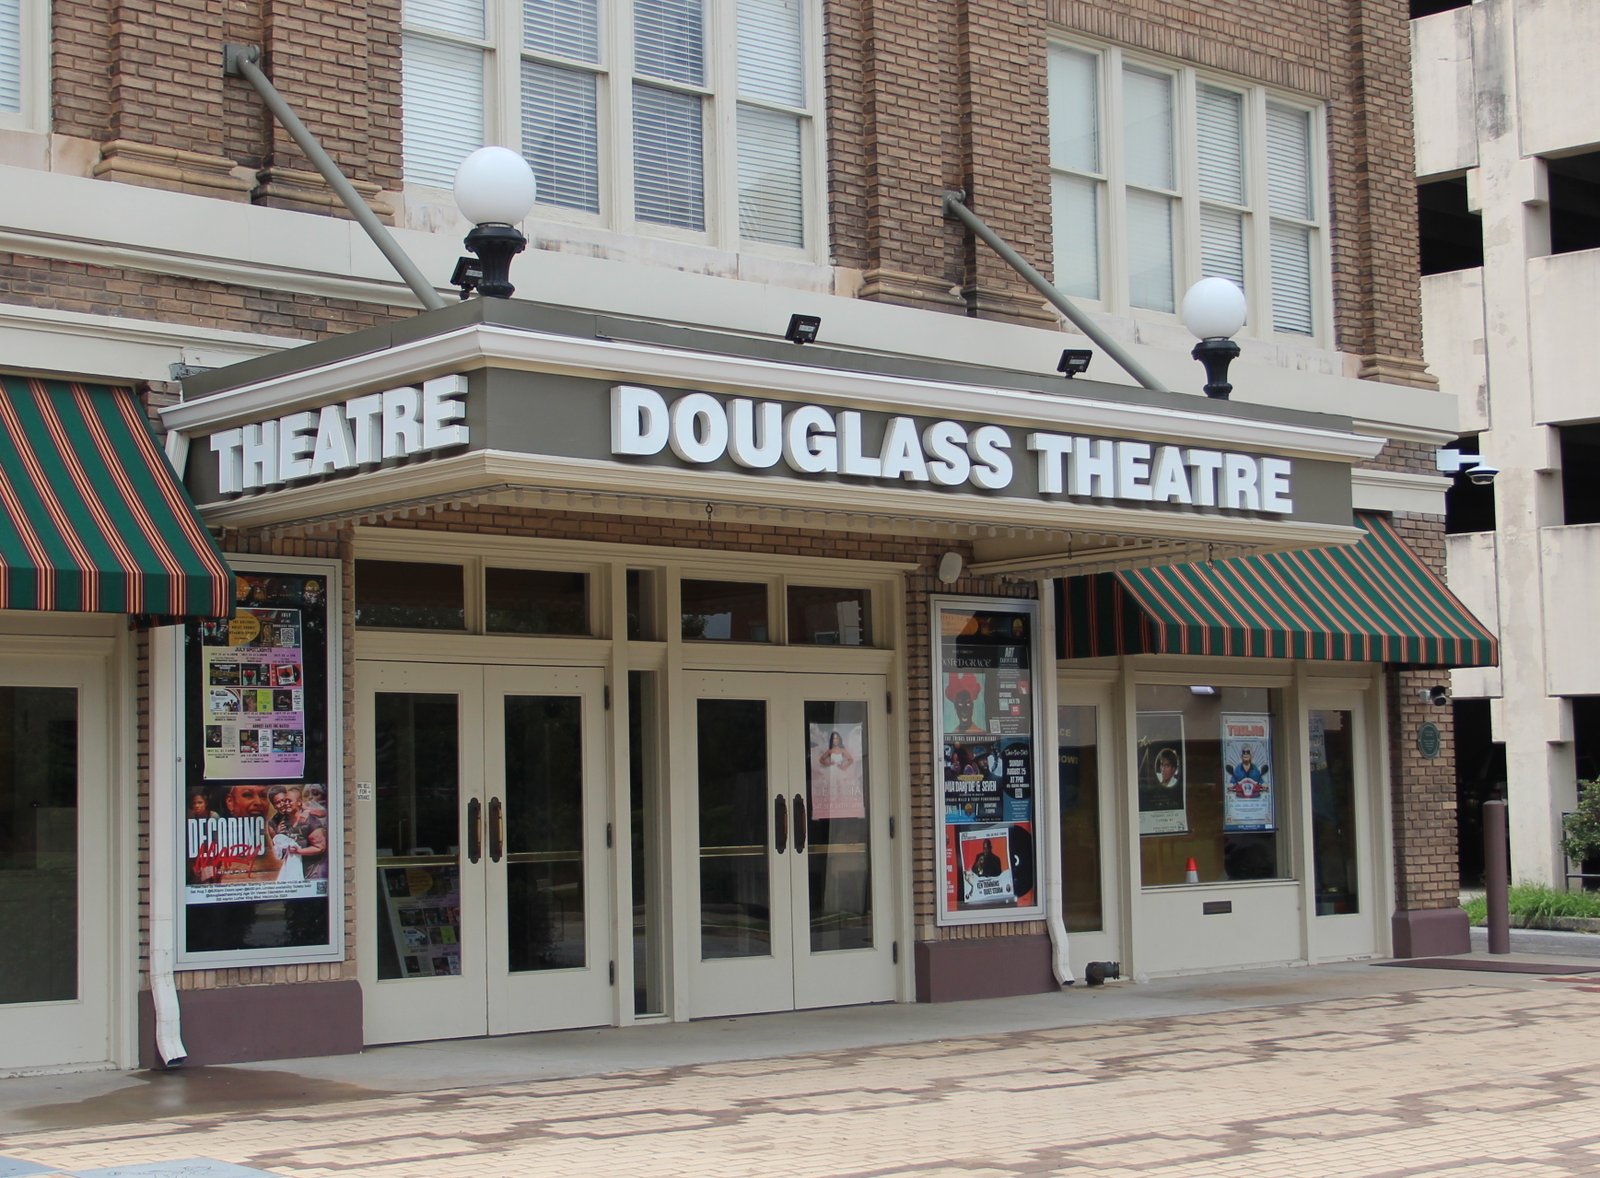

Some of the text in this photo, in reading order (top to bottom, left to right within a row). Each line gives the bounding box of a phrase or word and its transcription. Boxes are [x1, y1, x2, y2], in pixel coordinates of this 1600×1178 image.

[210, 374, 470, 494] THEATRE
[610, 384, 1293, 514] DOUGLASS THEATRE
[1004, 648, 1014, 658] ART
[982, 780, 996, 792] SEVEN
[188, 816, 266, 858] DECODING
